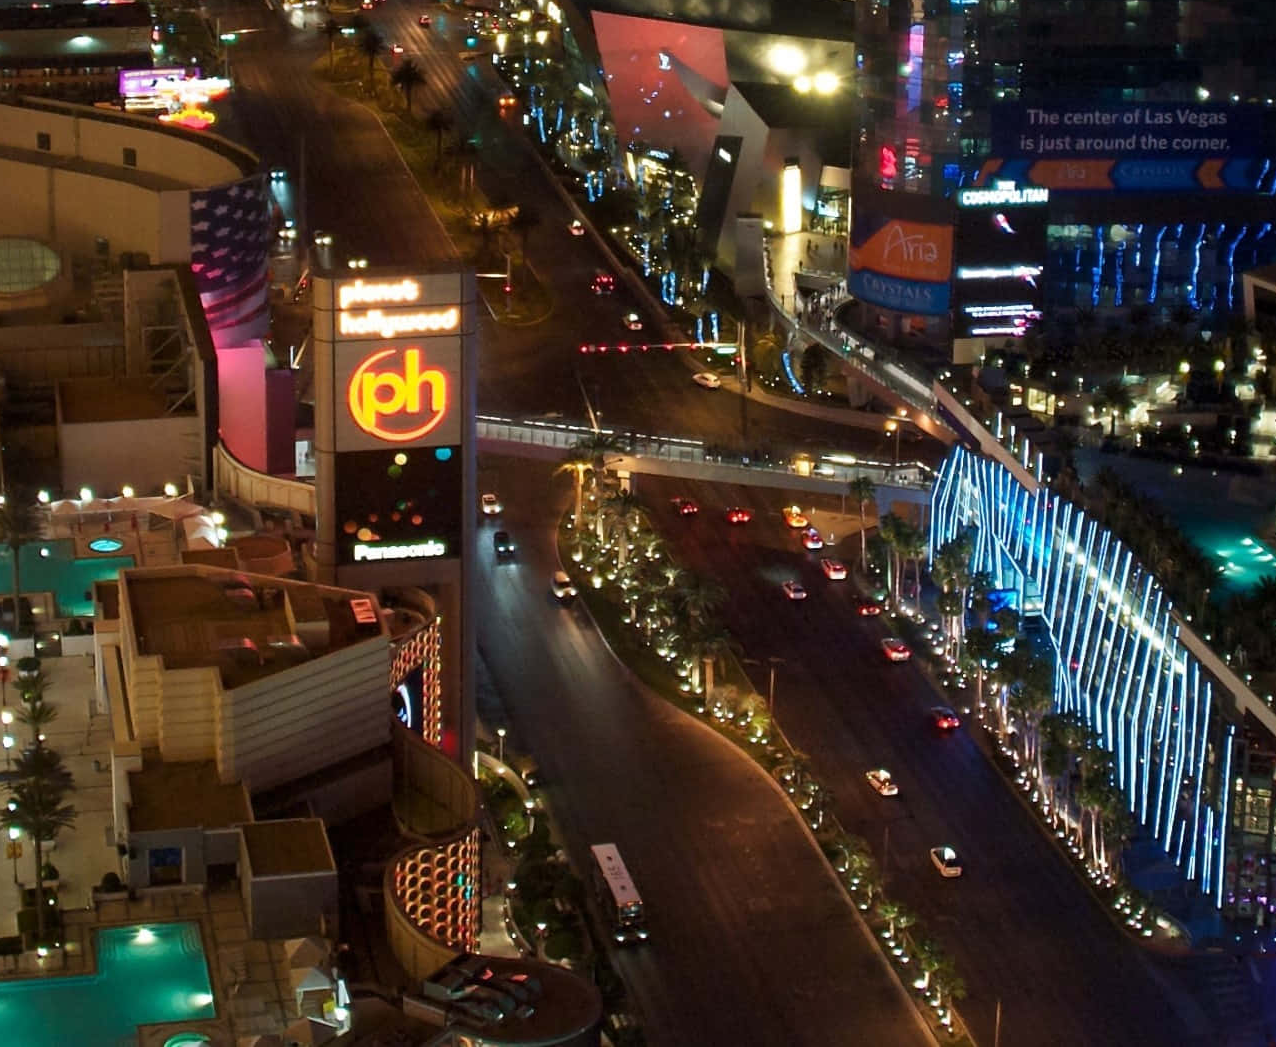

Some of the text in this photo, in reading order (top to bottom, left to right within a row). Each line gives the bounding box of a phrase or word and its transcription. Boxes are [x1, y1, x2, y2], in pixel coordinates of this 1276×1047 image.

[1027, 108, 1228, 129] The center of Las Vegas
[1020, 134, 1231, 153] is just around the corner.
[882, 225, 938, 263] Aria
[339, 279, 419, 309] planet
[339, 307, 460, 338] hollywood
[362, 348, 447, 432] ph
[354, 540, 446, 561] Panasonic
